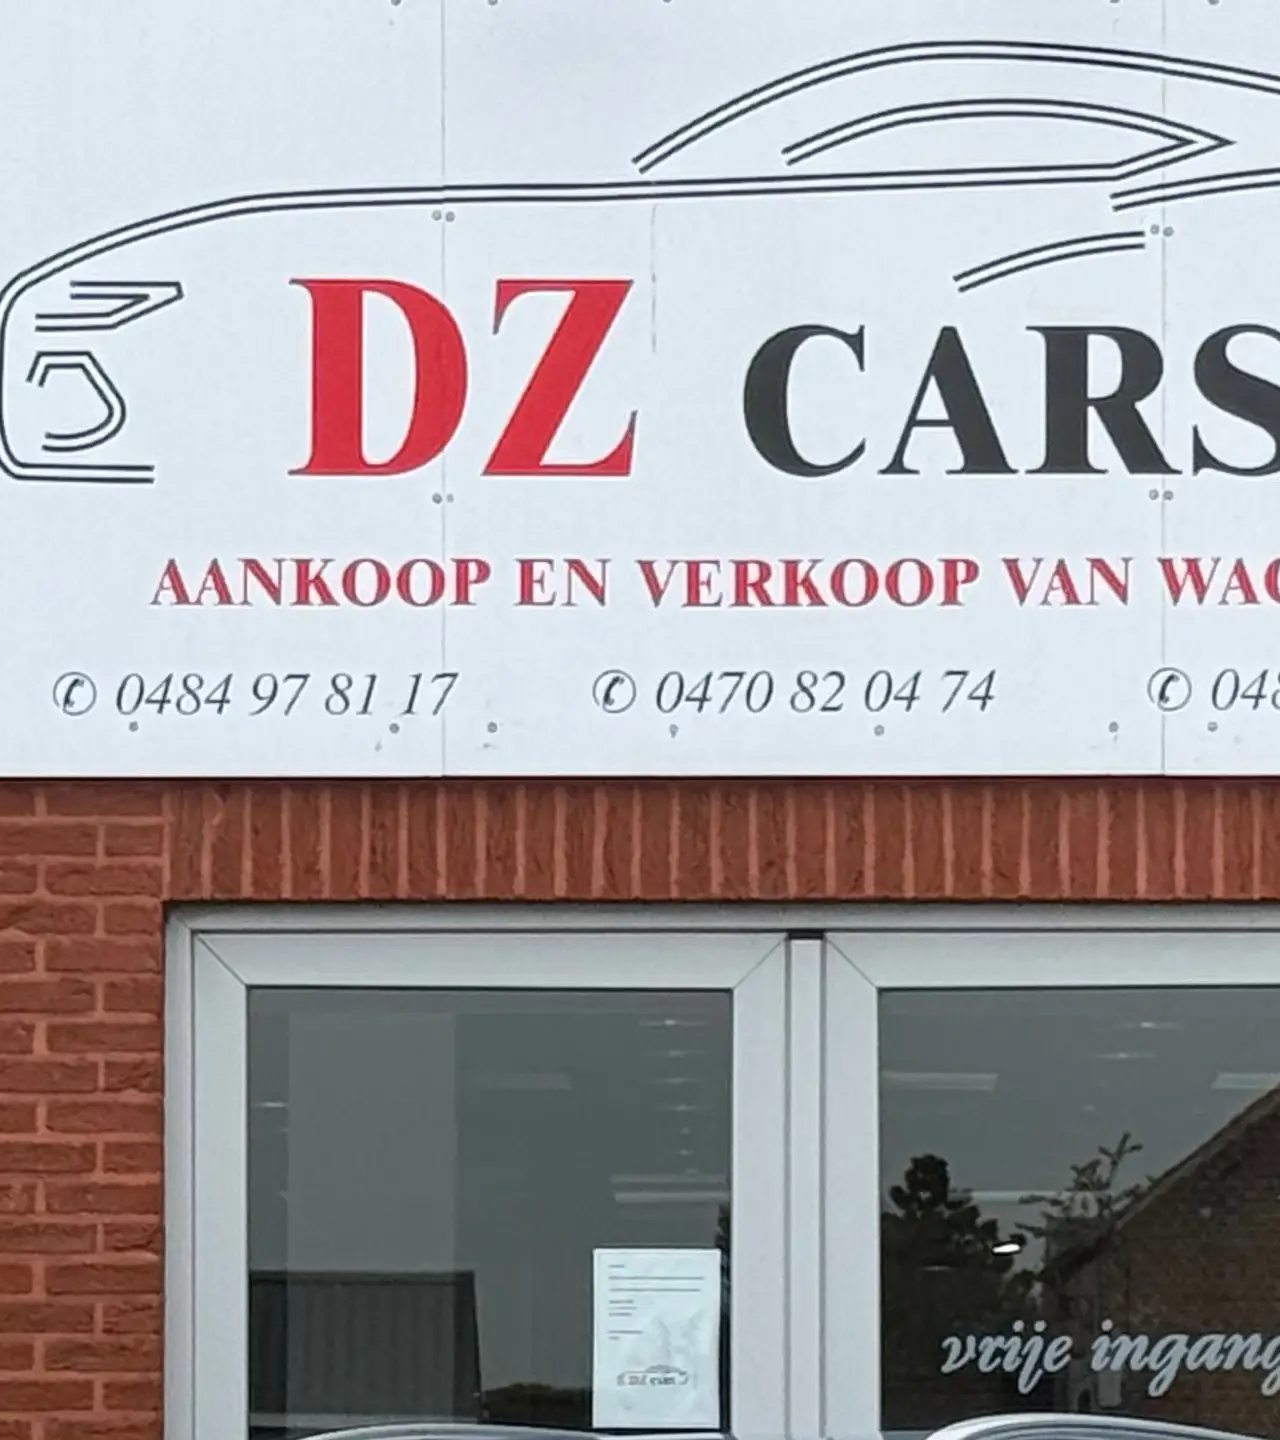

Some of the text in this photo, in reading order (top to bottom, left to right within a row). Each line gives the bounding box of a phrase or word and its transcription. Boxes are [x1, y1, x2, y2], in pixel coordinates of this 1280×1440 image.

[288, 279, 637, 476] DZ
[151, 559, 490, 606] AANKOOP
[515, 558, 610, 607] EN
[637, 559, 978, 607] VERKOOP
[1003, 558, 1131, 605] VAN
[117, 673, 459, 715] 0484 97 81 17
[656, 670, 996, 713] 0470 82 04 74
[941, 1319, 1073, 1394] vrije
